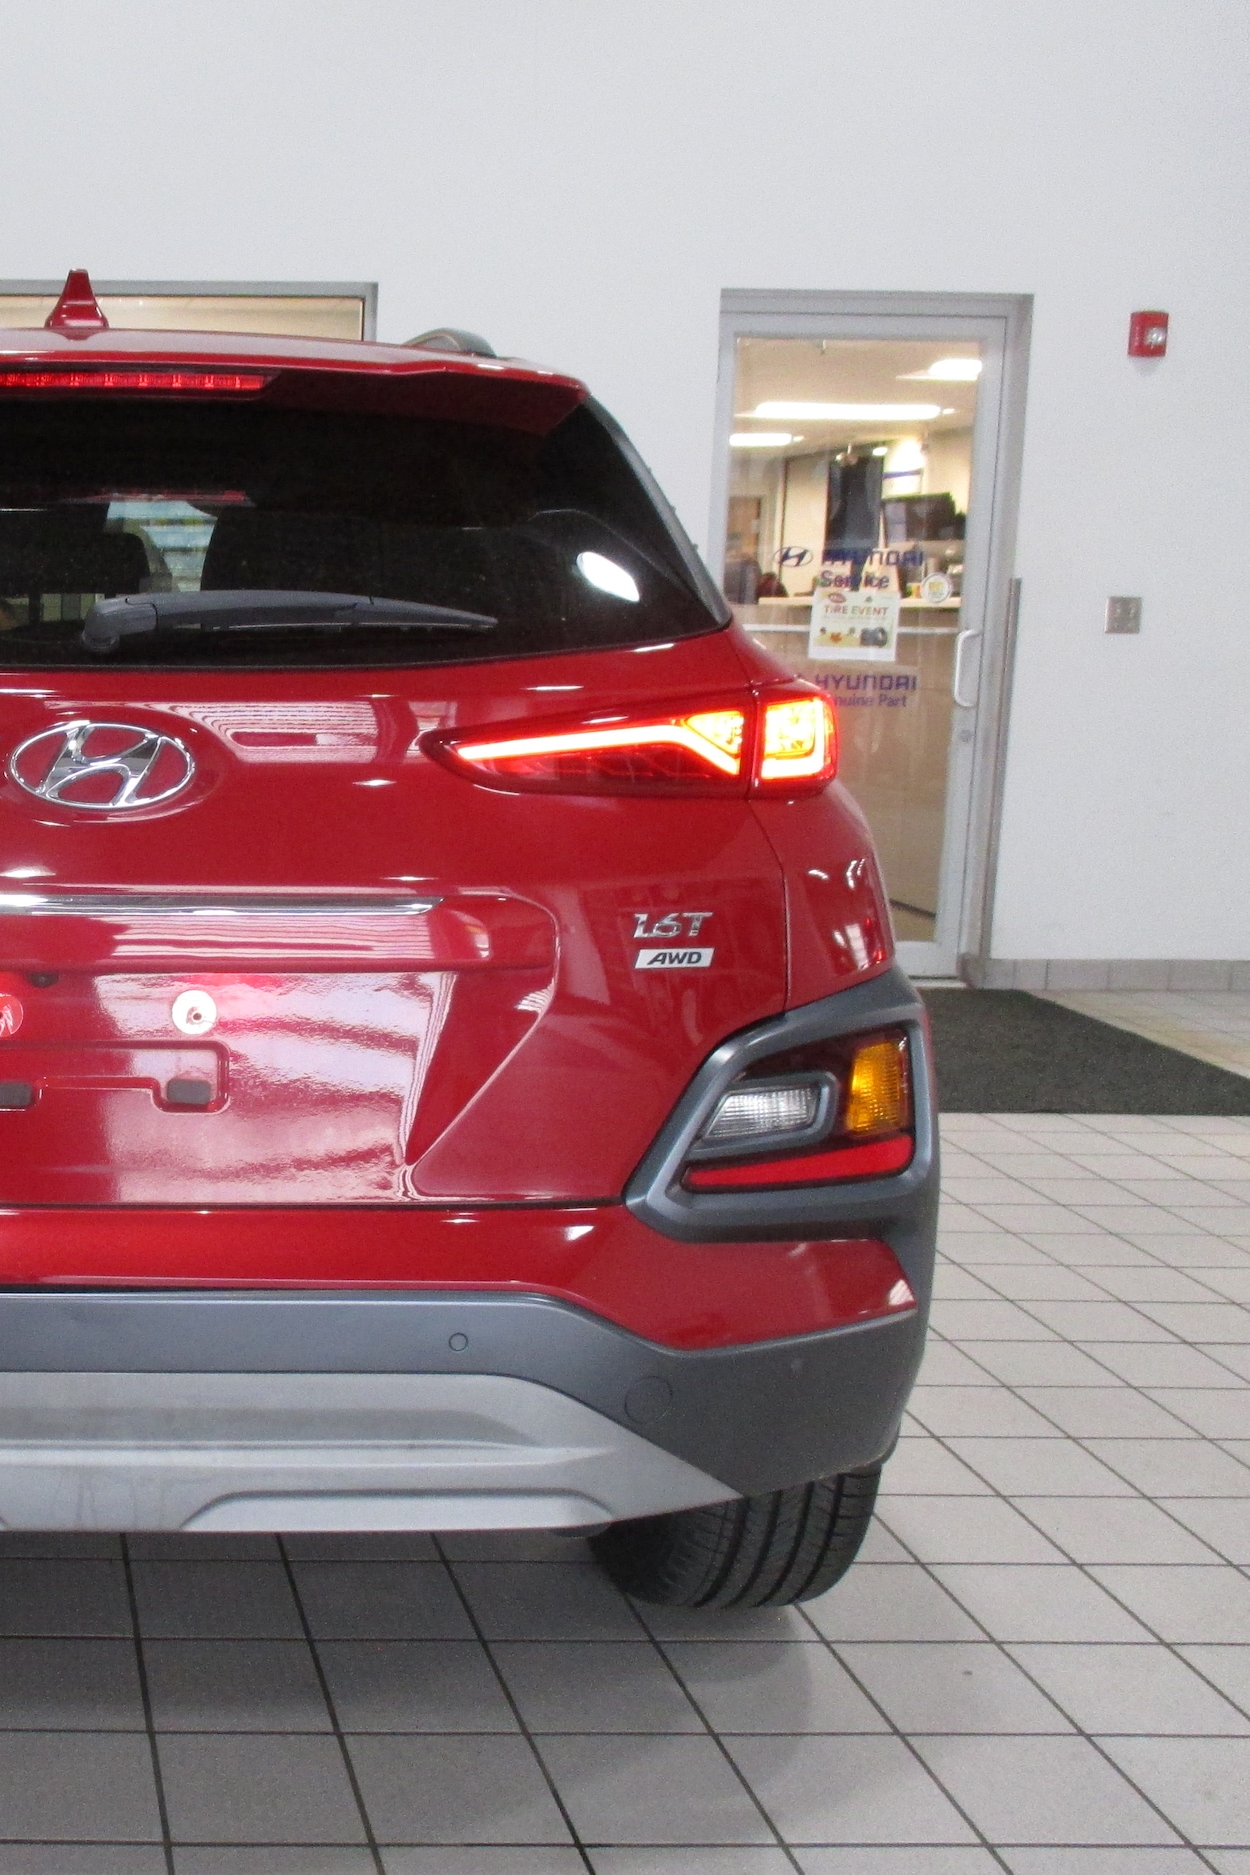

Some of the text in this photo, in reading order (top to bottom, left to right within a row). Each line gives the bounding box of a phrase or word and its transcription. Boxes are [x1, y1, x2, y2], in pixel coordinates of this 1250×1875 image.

[820, 569, 890, 589] Service
[824, 604, 889, 617] TIRE EVENT
[814, 673, 918, 691] HYUNDAI
[877, 694, 907, 708] Part
[646, 951, 702, 965] AWD
